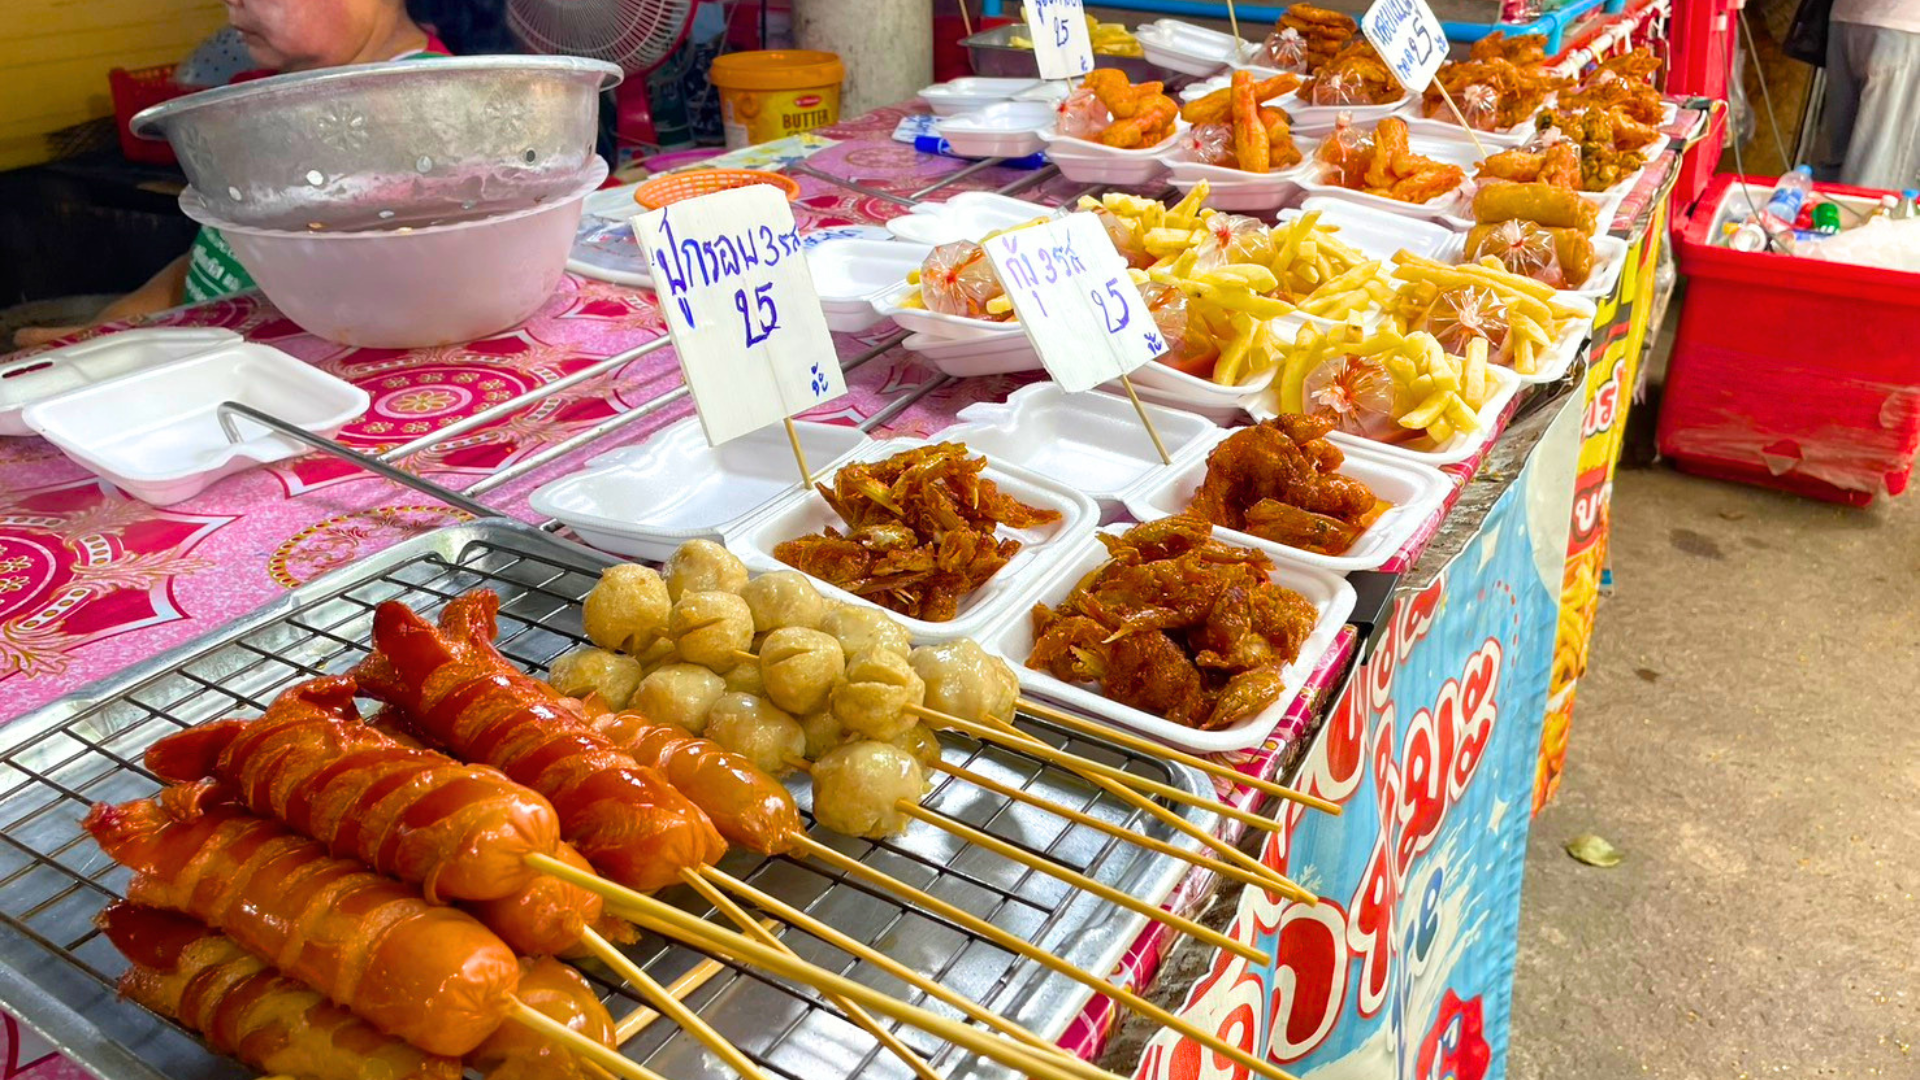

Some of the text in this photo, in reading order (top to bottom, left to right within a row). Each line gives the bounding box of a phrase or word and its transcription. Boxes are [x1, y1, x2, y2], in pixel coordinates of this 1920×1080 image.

[1408, 16, 1432, 66] 25
[782, 108, 830, 129] BUTTER
[734, 281, 781, 348] 25
[1091, 277, 1130, 334] 25
